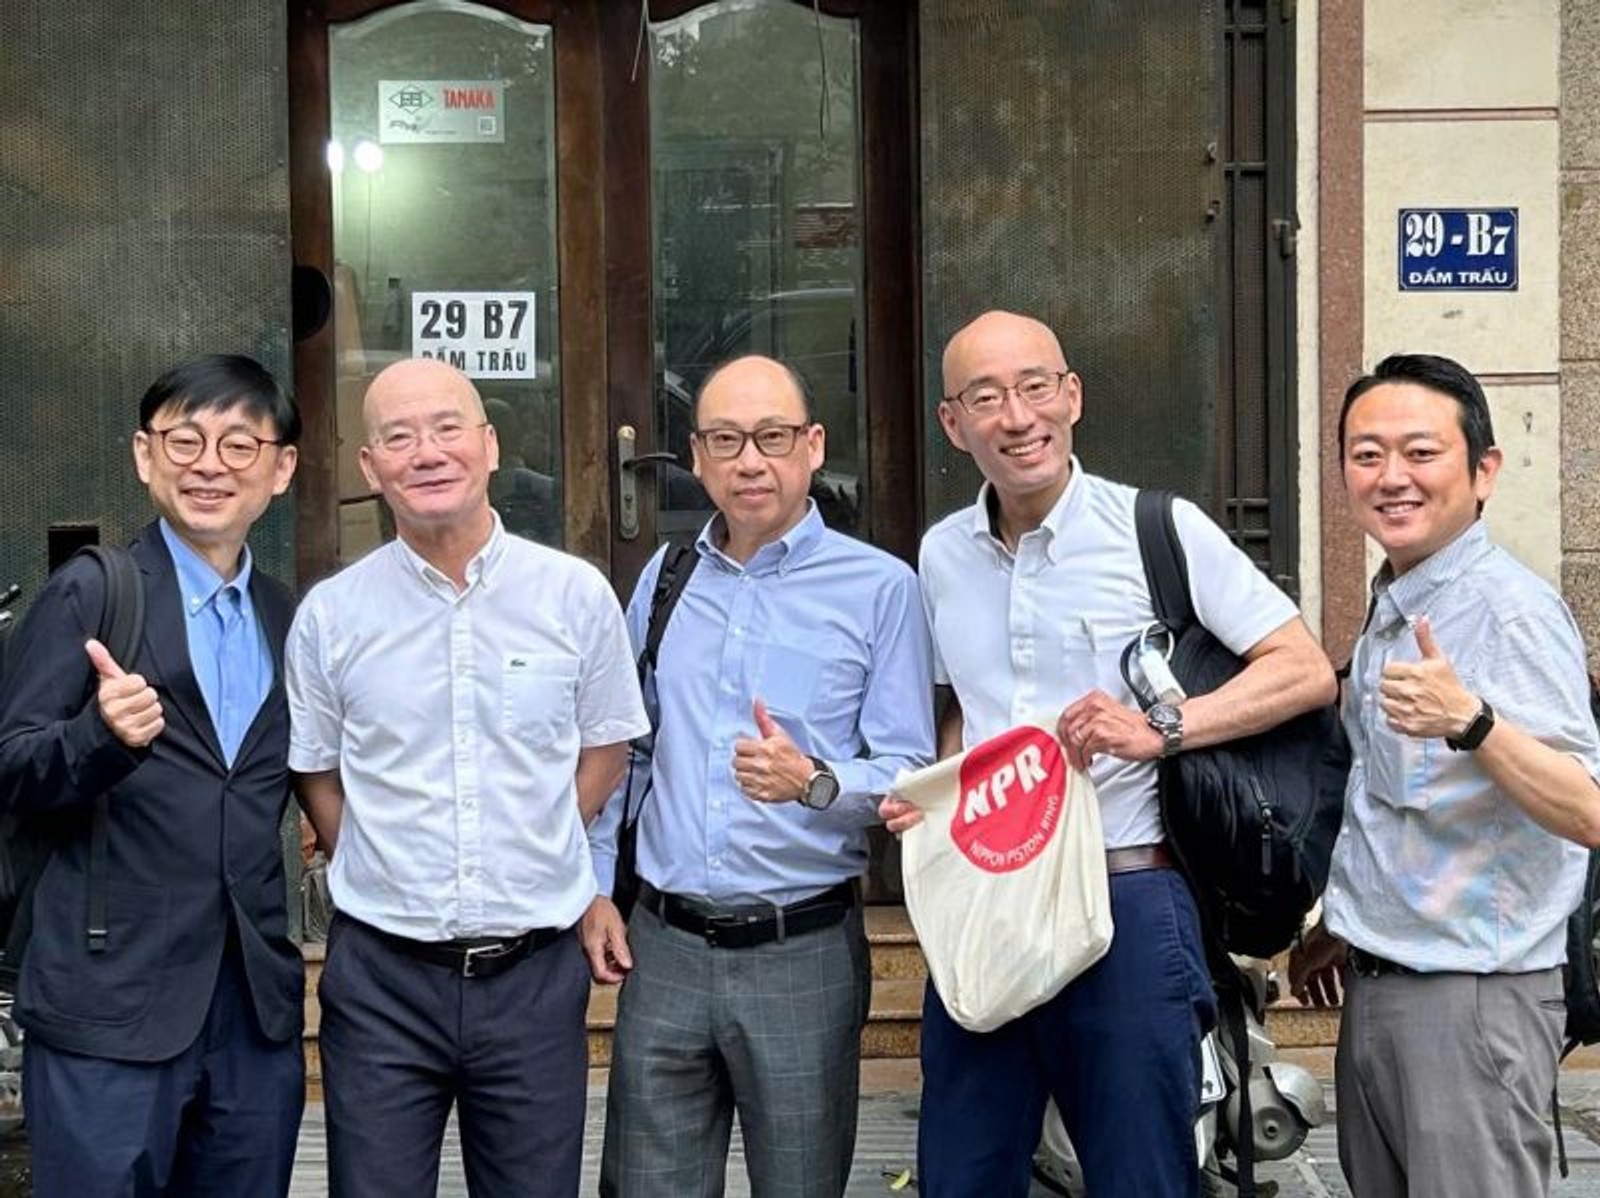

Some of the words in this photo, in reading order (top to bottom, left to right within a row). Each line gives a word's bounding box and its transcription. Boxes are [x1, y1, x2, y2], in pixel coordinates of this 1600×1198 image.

[444, 89, 495, 109] TANAKA
[1405, 212, 1445, 257] 29
[1450, 234, 1464, 245] -
[1466, 213, 1512, 256] B7
[420, 300, 467, 339] 29
[483, 300, 529, 339] B7
[963, 743, 1048, 825] NPR
[1006, 831, 1045, 865] PISTON
